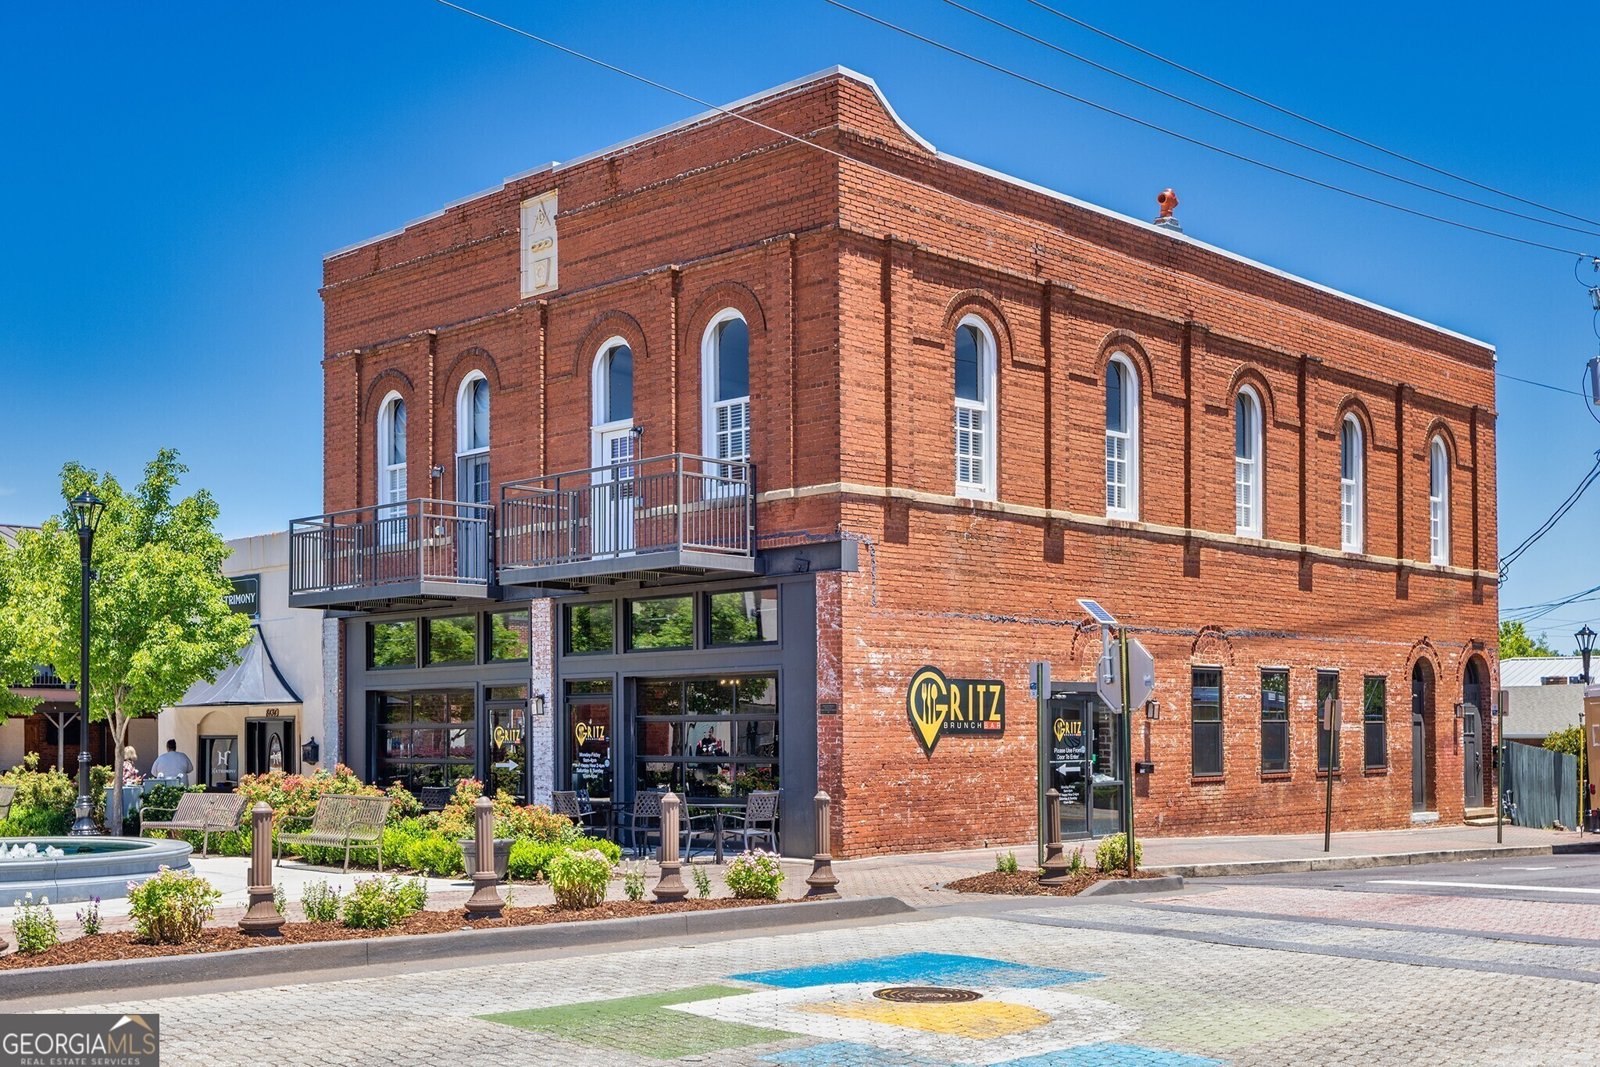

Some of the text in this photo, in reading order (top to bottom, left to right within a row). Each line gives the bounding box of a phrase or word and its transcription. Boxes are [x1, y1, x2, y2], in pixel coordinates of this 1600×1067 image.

[910, 671, 1001, 749] GRITZ
[494, 726, 520, 749] GRITZ
[575, 722, 605, 746] GRITZ
[943, 721, 1001, 730] BRUNCH BAR
[1054, 718, 1082, 742] GRITZ
